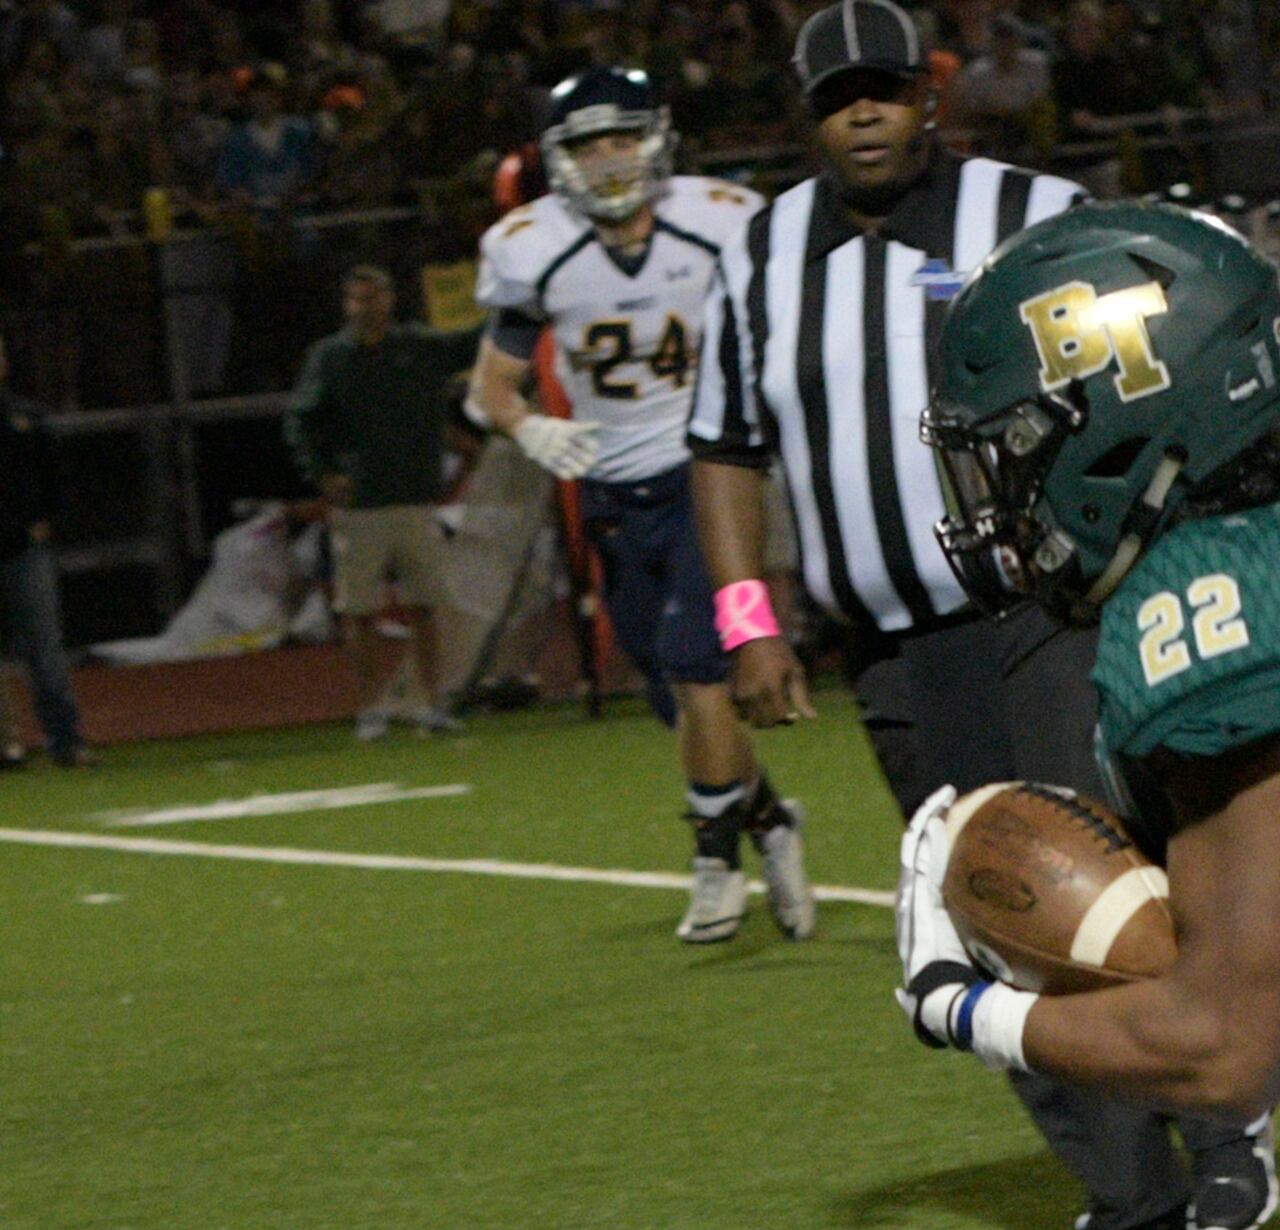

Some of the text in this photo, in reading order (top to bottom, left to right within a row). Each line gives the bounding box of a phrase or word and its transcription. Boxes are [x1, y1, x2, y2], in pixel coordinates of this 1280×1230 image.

[581, 309, 699, 400] 24
[1019, 281, 1171, 402] BT
[1137, 573, 1250, 687] 22
